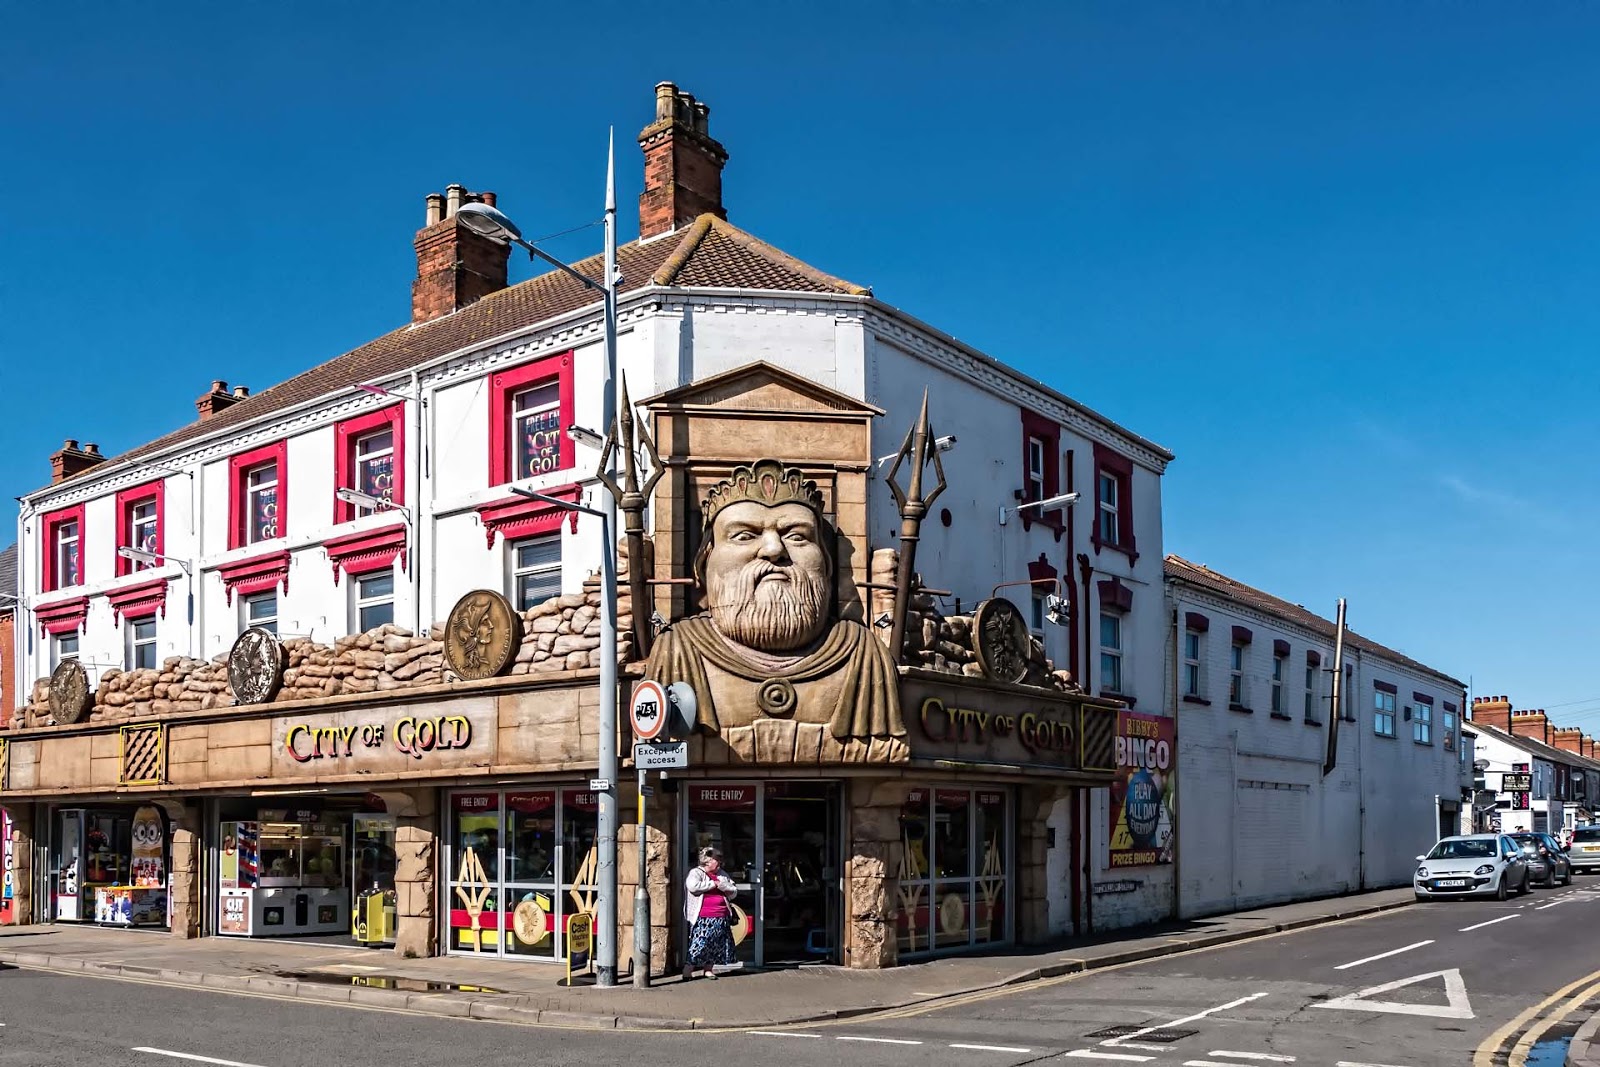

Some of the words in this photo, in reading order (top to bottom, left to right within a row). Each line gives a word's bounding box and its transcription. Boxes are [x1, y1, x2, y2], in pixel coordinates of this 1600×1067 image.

[526, 414, 545, 433] FREE
[532, 430, 560, 449] CIT
[541, 447, 553, 457] OF
[530, 454, 560, 475] GOL
[375, 474, 393, 489] CI
[374, 497, 392, 512] GO
[921, 697, 989, 743] CITY
[994, 715, 1015, 736] OF
[1020, 712, 1075, 753] GOLD
[1126, 718, 1158, 737] BIBBY'S
[286, 724, 358, 762] CITY
[362, 724, 385, 747] OF
[393, 715, 472, 759] GOLD
[638, 746, 667, 756] Except
[670, 745, 684, 754] for
[1115, 736, 1170, 769] BINGO
[575, 794, 588, 804] FREE
[701, 789, 718, 800] FREE
[721, 789, 744, 800] ENTRY
[1134, 783, 1152, 800] PLAY
[461, 798, 472, 807] FREE
[473, 797, 489, 807] ENTRY
[1129, 802, 1143, 820] ALL
[1143, 802, 1157, 820] DAY
[1130, 818, 1156, 835] EVERYDAY
[1119, 831, 1130, 845] 17
[1113, 853, 1133, 866] PRIZE
[1134, 852, 1156, 865] BINGO
[226, 898, 244, 911] CUT
[572, 922, 588, 934] Cash
